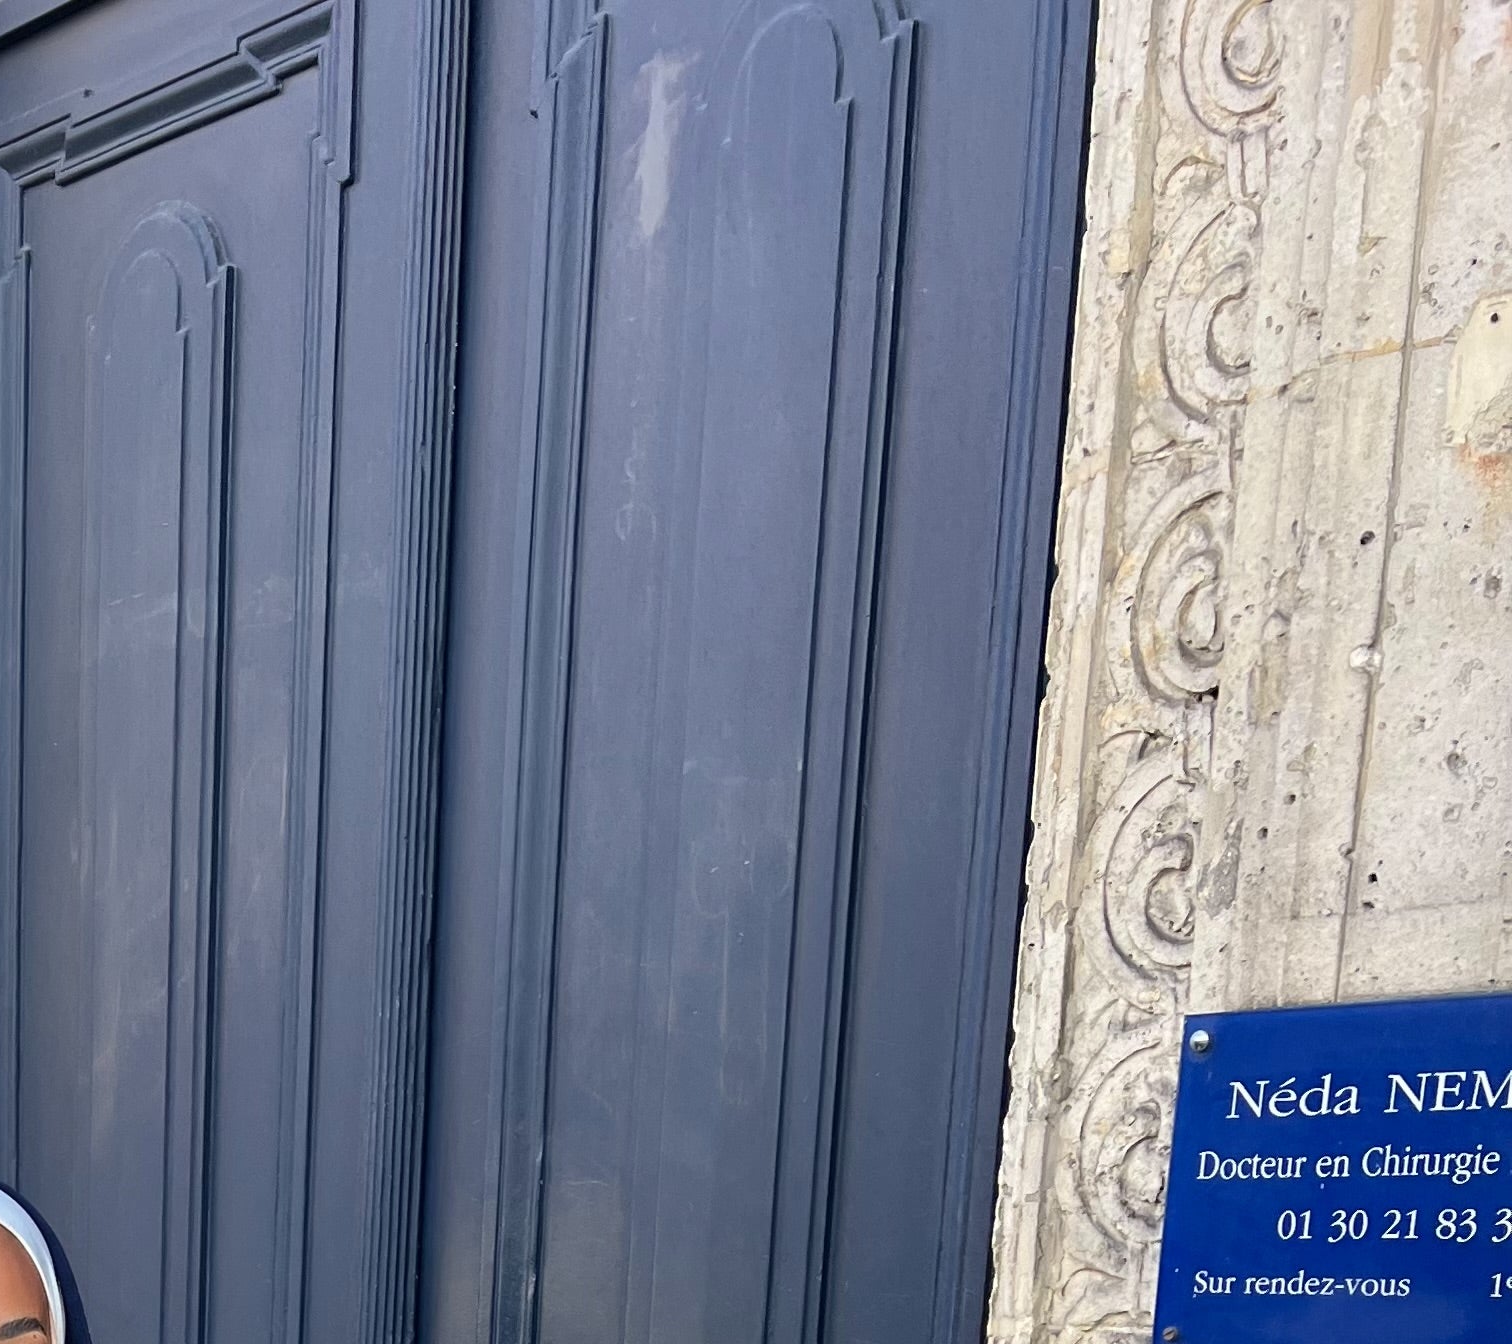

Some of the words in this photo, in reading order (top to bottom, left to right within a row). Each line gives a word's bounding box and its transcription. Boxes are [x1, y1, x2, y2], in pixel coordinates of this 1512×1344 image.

[1225, 1073, 1361, 1119] Néda
[1383, 1069, 1512, 1113] NEM
[1196, 1150, 1308, 1180] Docteur
[1315, 1155, 1350, 1178] en
[1361, 1144, 1501, 1185] Chirurgie
[1277, 1209, 1313, 1240] 01
[1327, 1209, 1369, 1243] 30
[1381, 1209, 1419, 1240] 21
[1435, 1208, 1477, 1243] 83
[1193, 1270, 1237, 1295] Sur
[1243, 1269, 1411, 1298] rendez-vous
